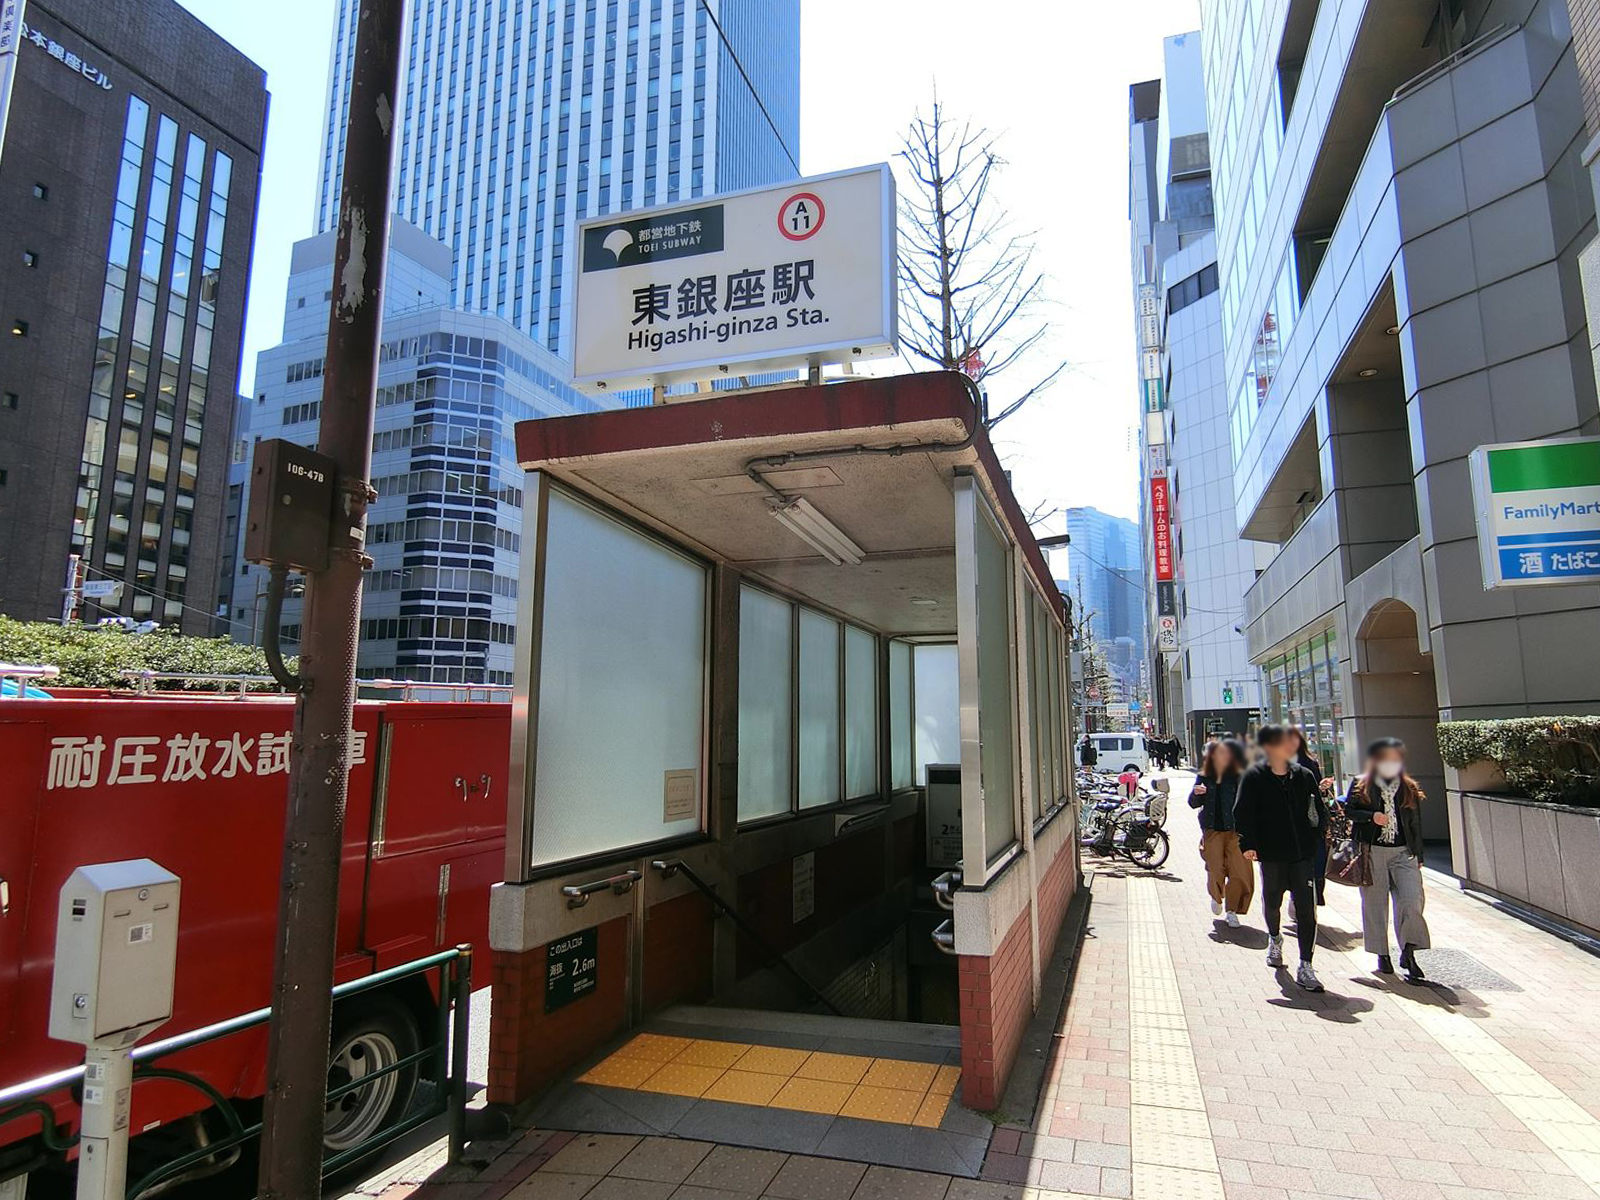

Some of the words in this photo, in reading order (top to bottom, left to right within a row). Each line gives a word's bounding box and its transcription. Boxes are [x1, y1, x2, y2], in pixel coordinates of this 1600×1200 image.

[795, 201, 808, 215] A
[638, 220, 702, 243] 都営地下鉄
[791, 215, 811, 231] 11
[638, 242, 660, 254] TOEI
[662, 235, 702, 251] SUBWAY
[631, 259, 816, 326] 東銀座駅
[627, 314, 779, 353] Higashi-ginza
[786, 306, 830, 327] Sta.
[1503, 501, 1600, 520] FamilyMart
[1518, 552, 1544, 574] 酒
[1551, 551, 1600, 571] たばこ
[572, 958, 596, 976] 2.6m
